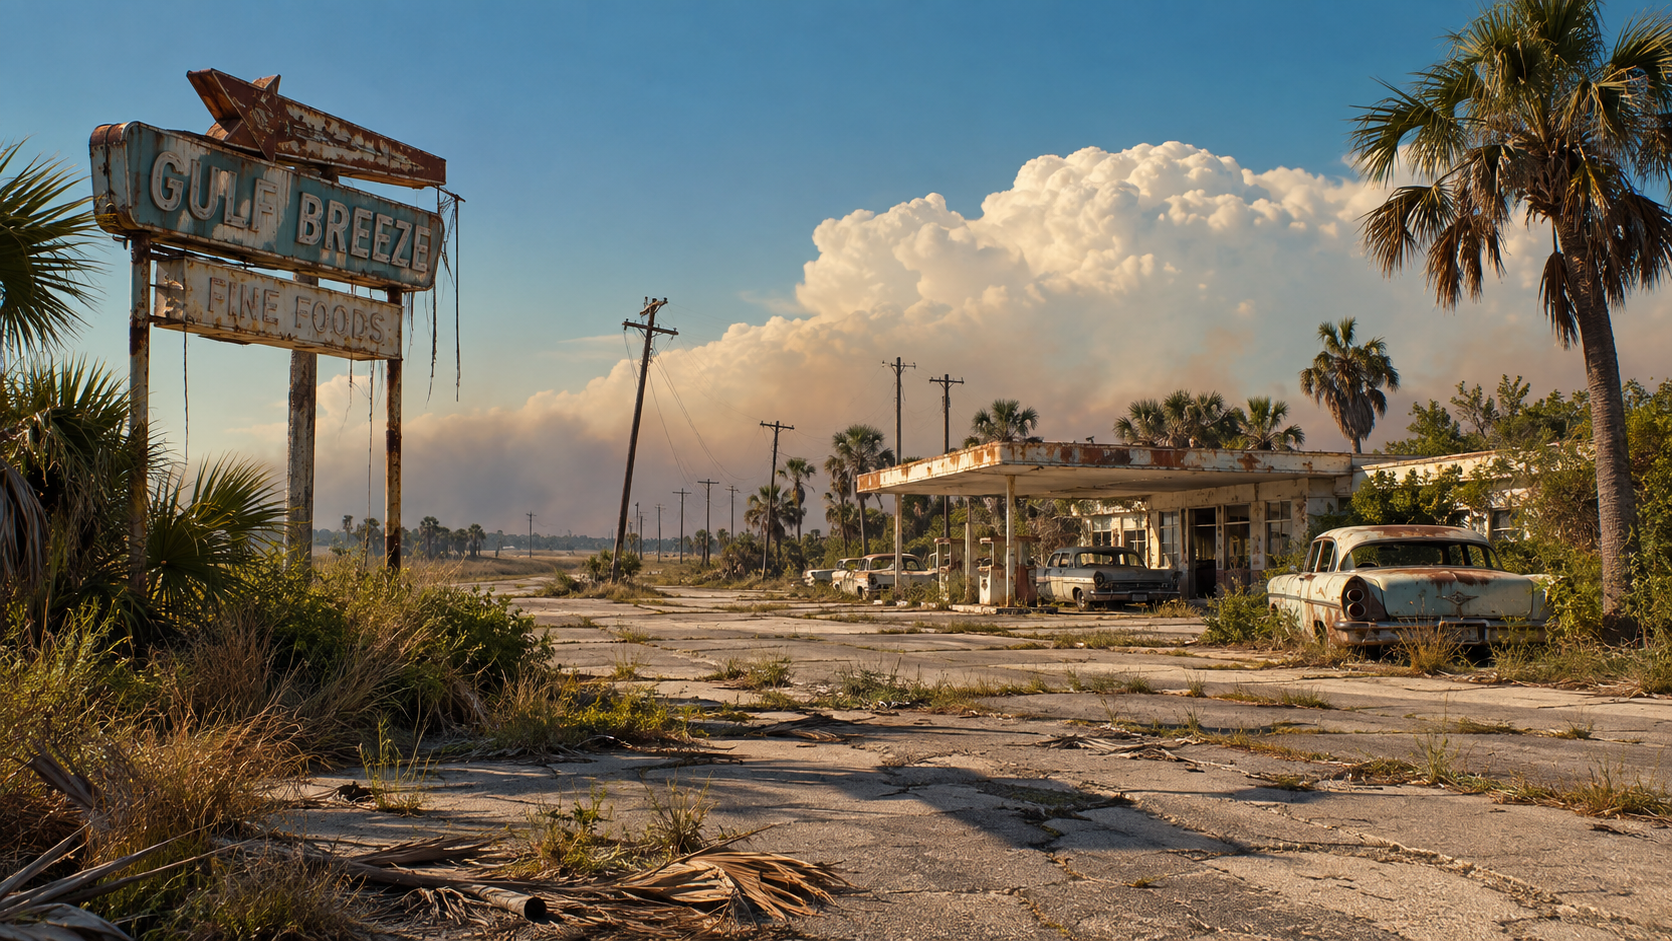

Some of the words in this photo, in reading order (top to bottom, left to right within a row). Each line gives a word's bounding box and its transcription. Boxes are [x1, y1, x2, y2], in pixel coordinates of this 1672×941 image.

[152, 152, 277, 232] GULF
[297, 193, 432, 273] BREEZE
[208, 277, 280, 325] FINE
[295, 295, 385, 343] FOODS
